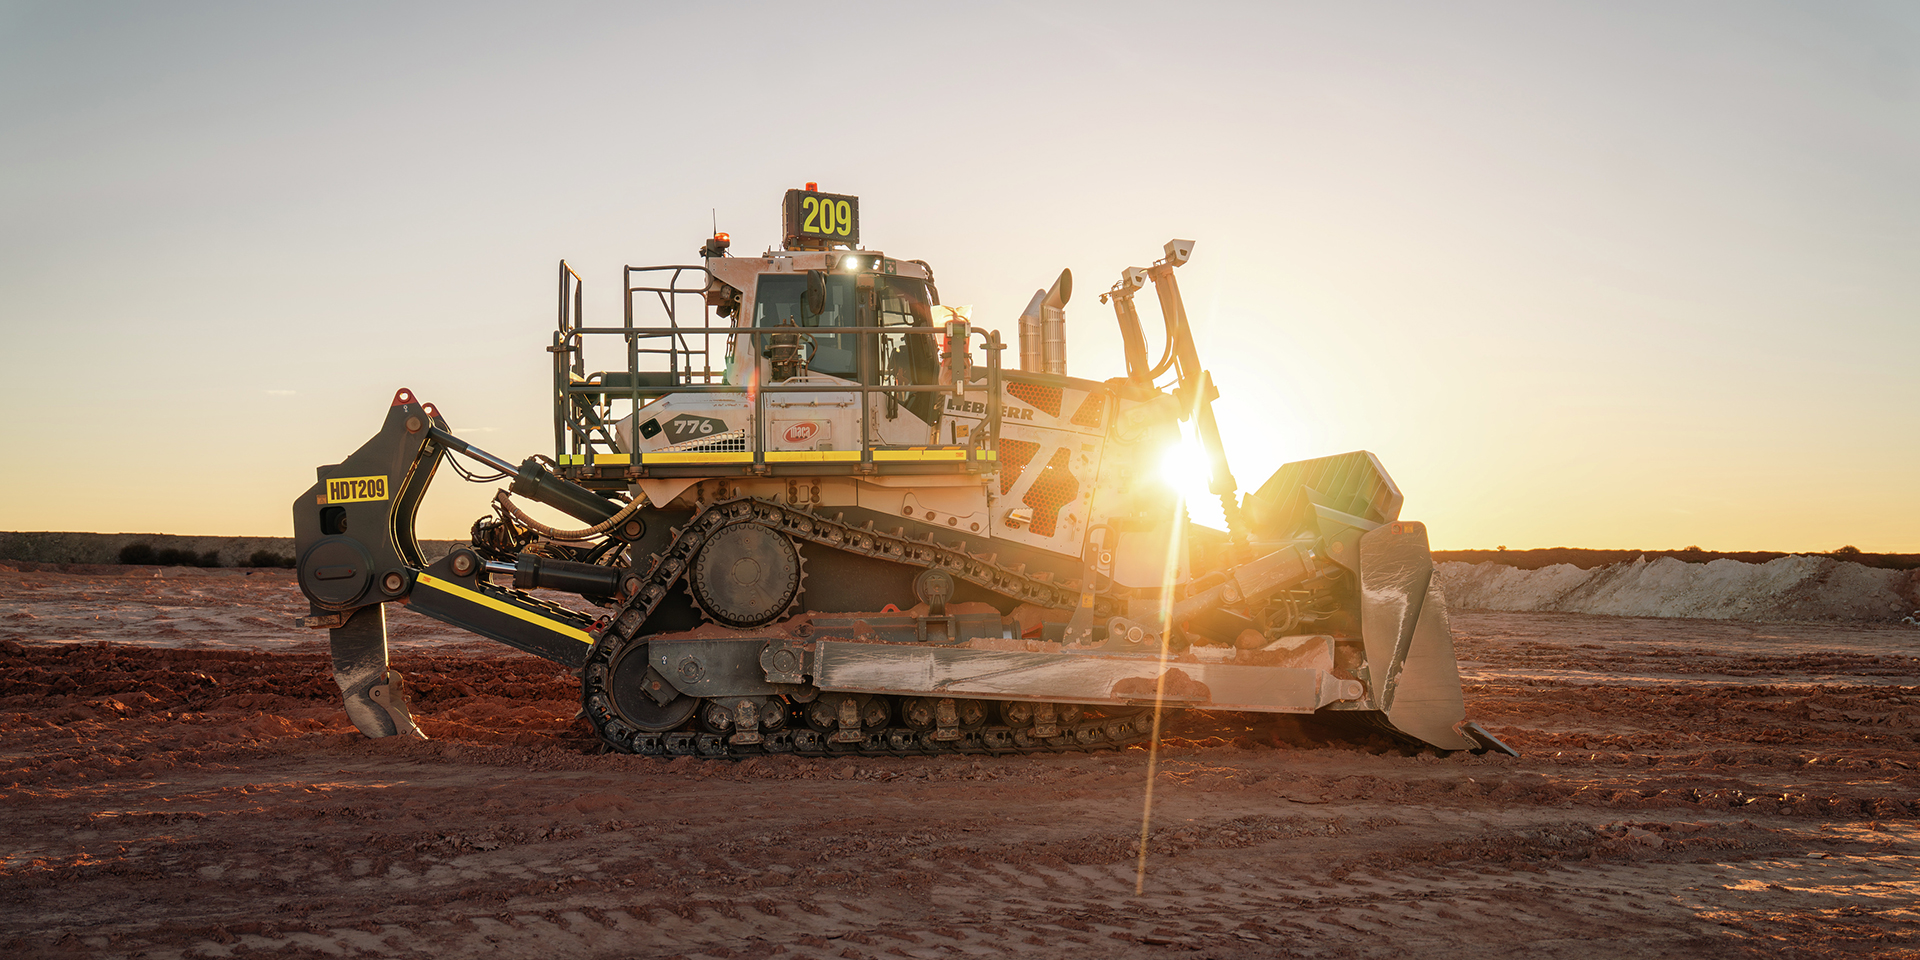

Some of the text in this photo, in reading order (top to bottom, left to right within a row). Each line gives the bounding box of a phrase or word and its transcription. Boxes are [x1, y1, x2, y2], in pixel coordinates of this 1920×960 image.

[803, 197, 851, 236] 209
[947, 399, 1034, 420] LEBERR
[674, 420, 713, 434] 776
[330, 479, 385, 500] HDT209
